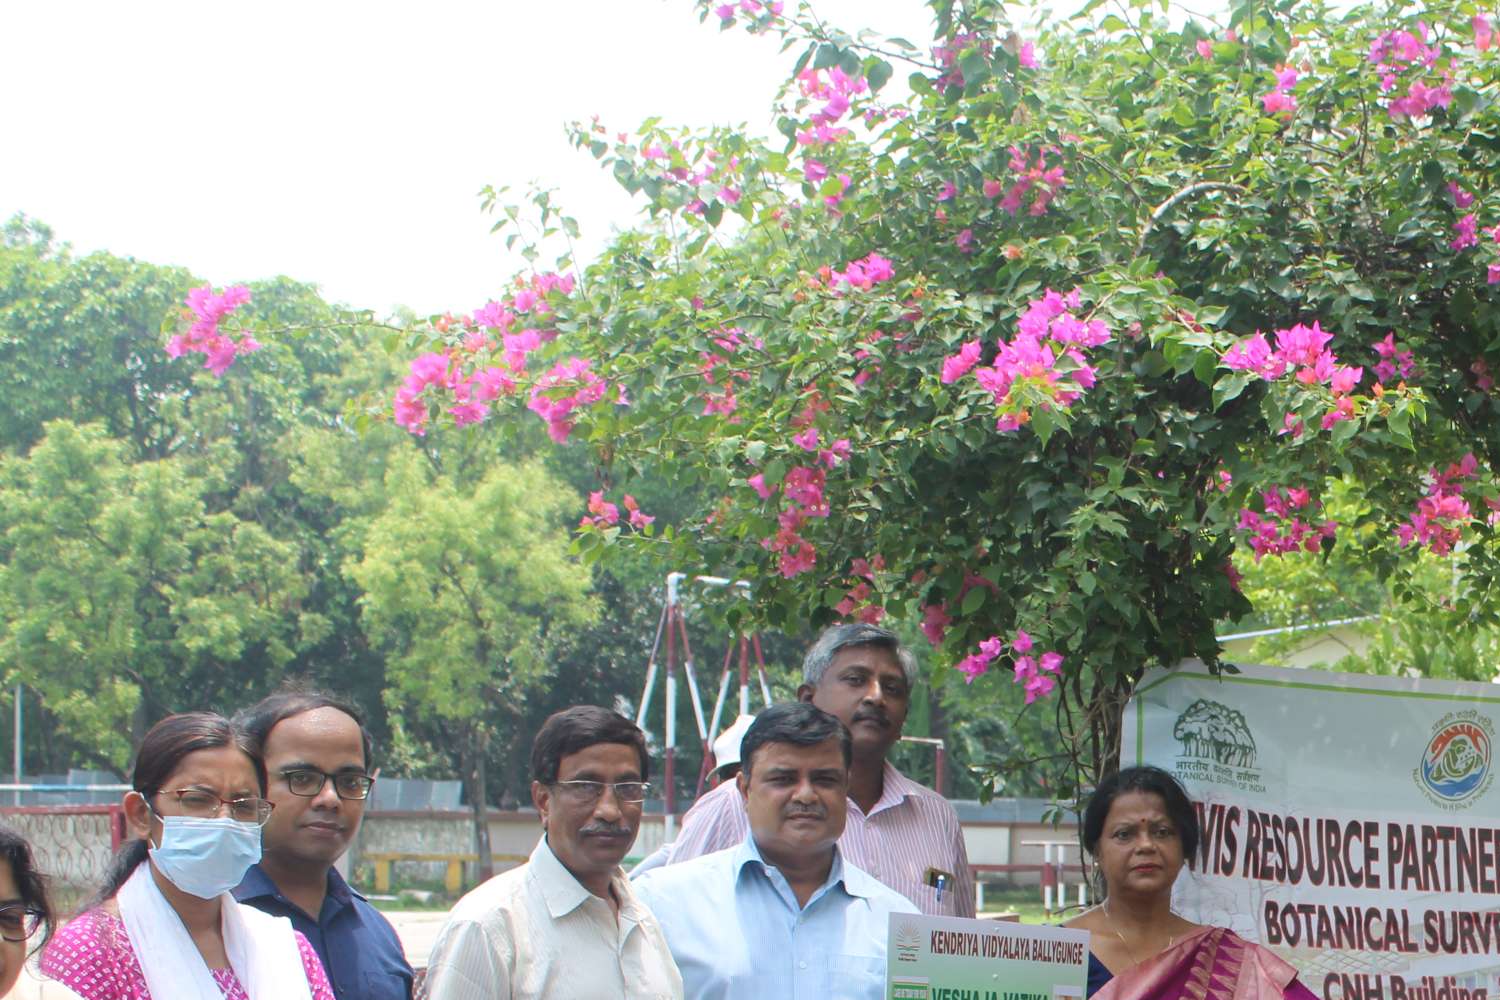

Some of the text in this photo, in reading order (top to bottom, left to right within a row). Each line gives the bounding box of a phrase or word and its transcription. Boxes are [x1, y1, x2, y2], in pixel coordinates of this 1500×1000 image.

[1243, 809, 1381, 888] RESOURCE
[930, 930, 1083, 965] KENDRIYA VIDYALAYA BALLYGUNGE
[1264, 900, 1418, 952] BOTANICAL
